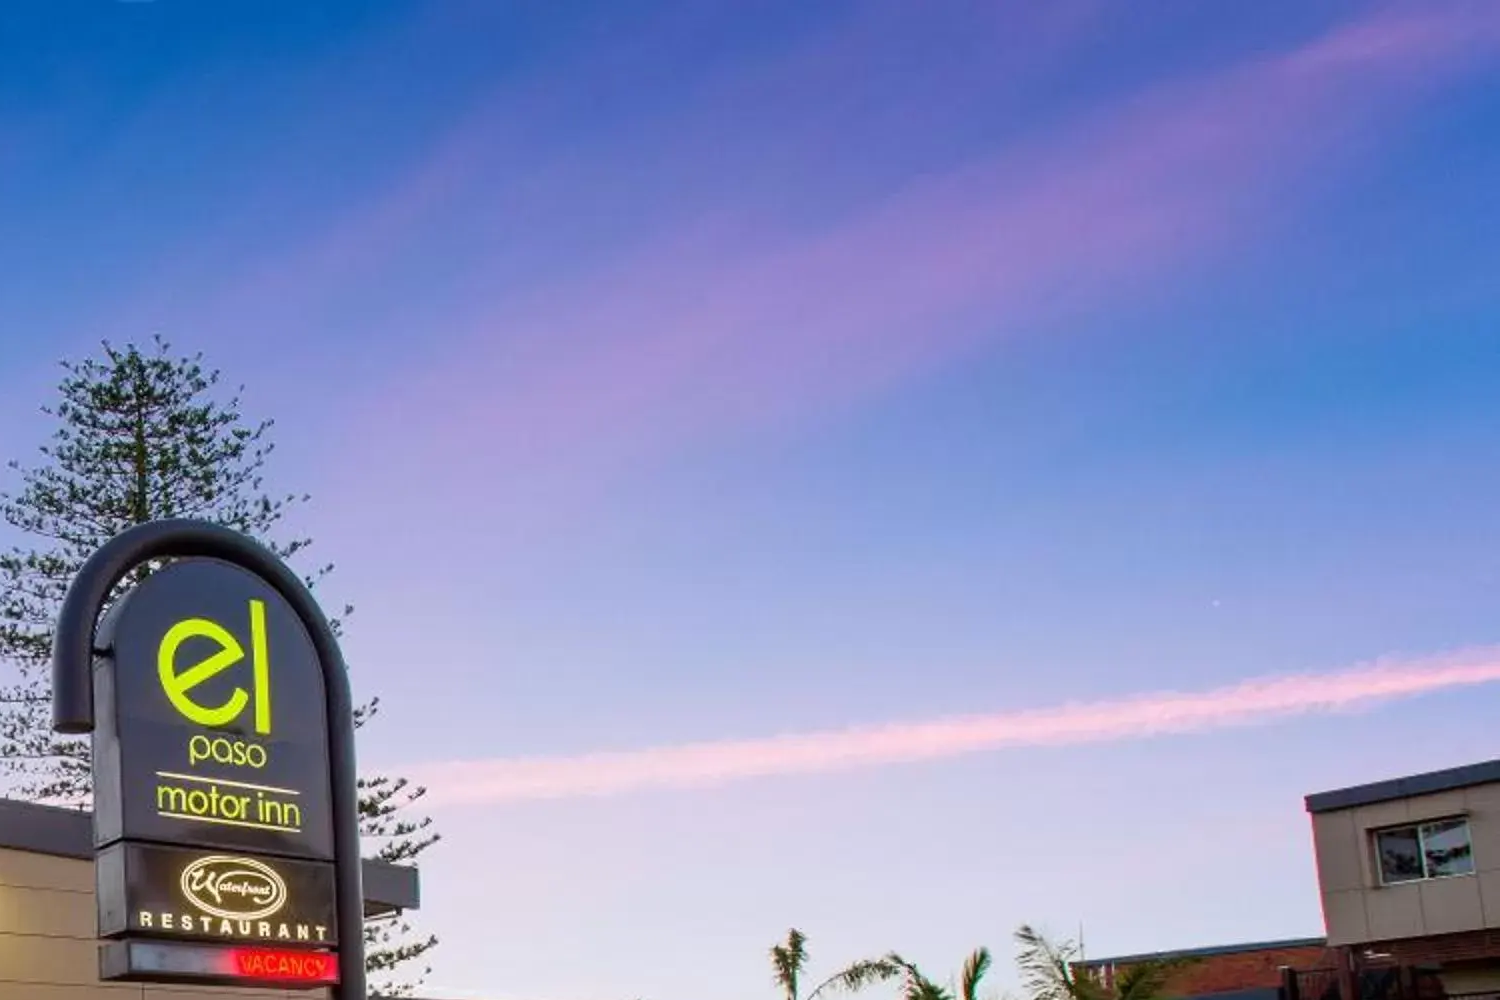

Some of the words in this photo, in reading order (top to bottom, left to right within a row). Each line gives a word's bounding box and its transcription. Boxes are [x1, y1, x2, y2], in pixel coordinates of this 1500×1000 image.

[156, 600, 271, 734] el
[189, 735, 267, 768] paso
[157, 785, 250, 819] motor
[257, 792, 301, 826] inn
[139, 911, 327, 941] RESTAURANT
[239, 954, 327, 976] VACANCY
